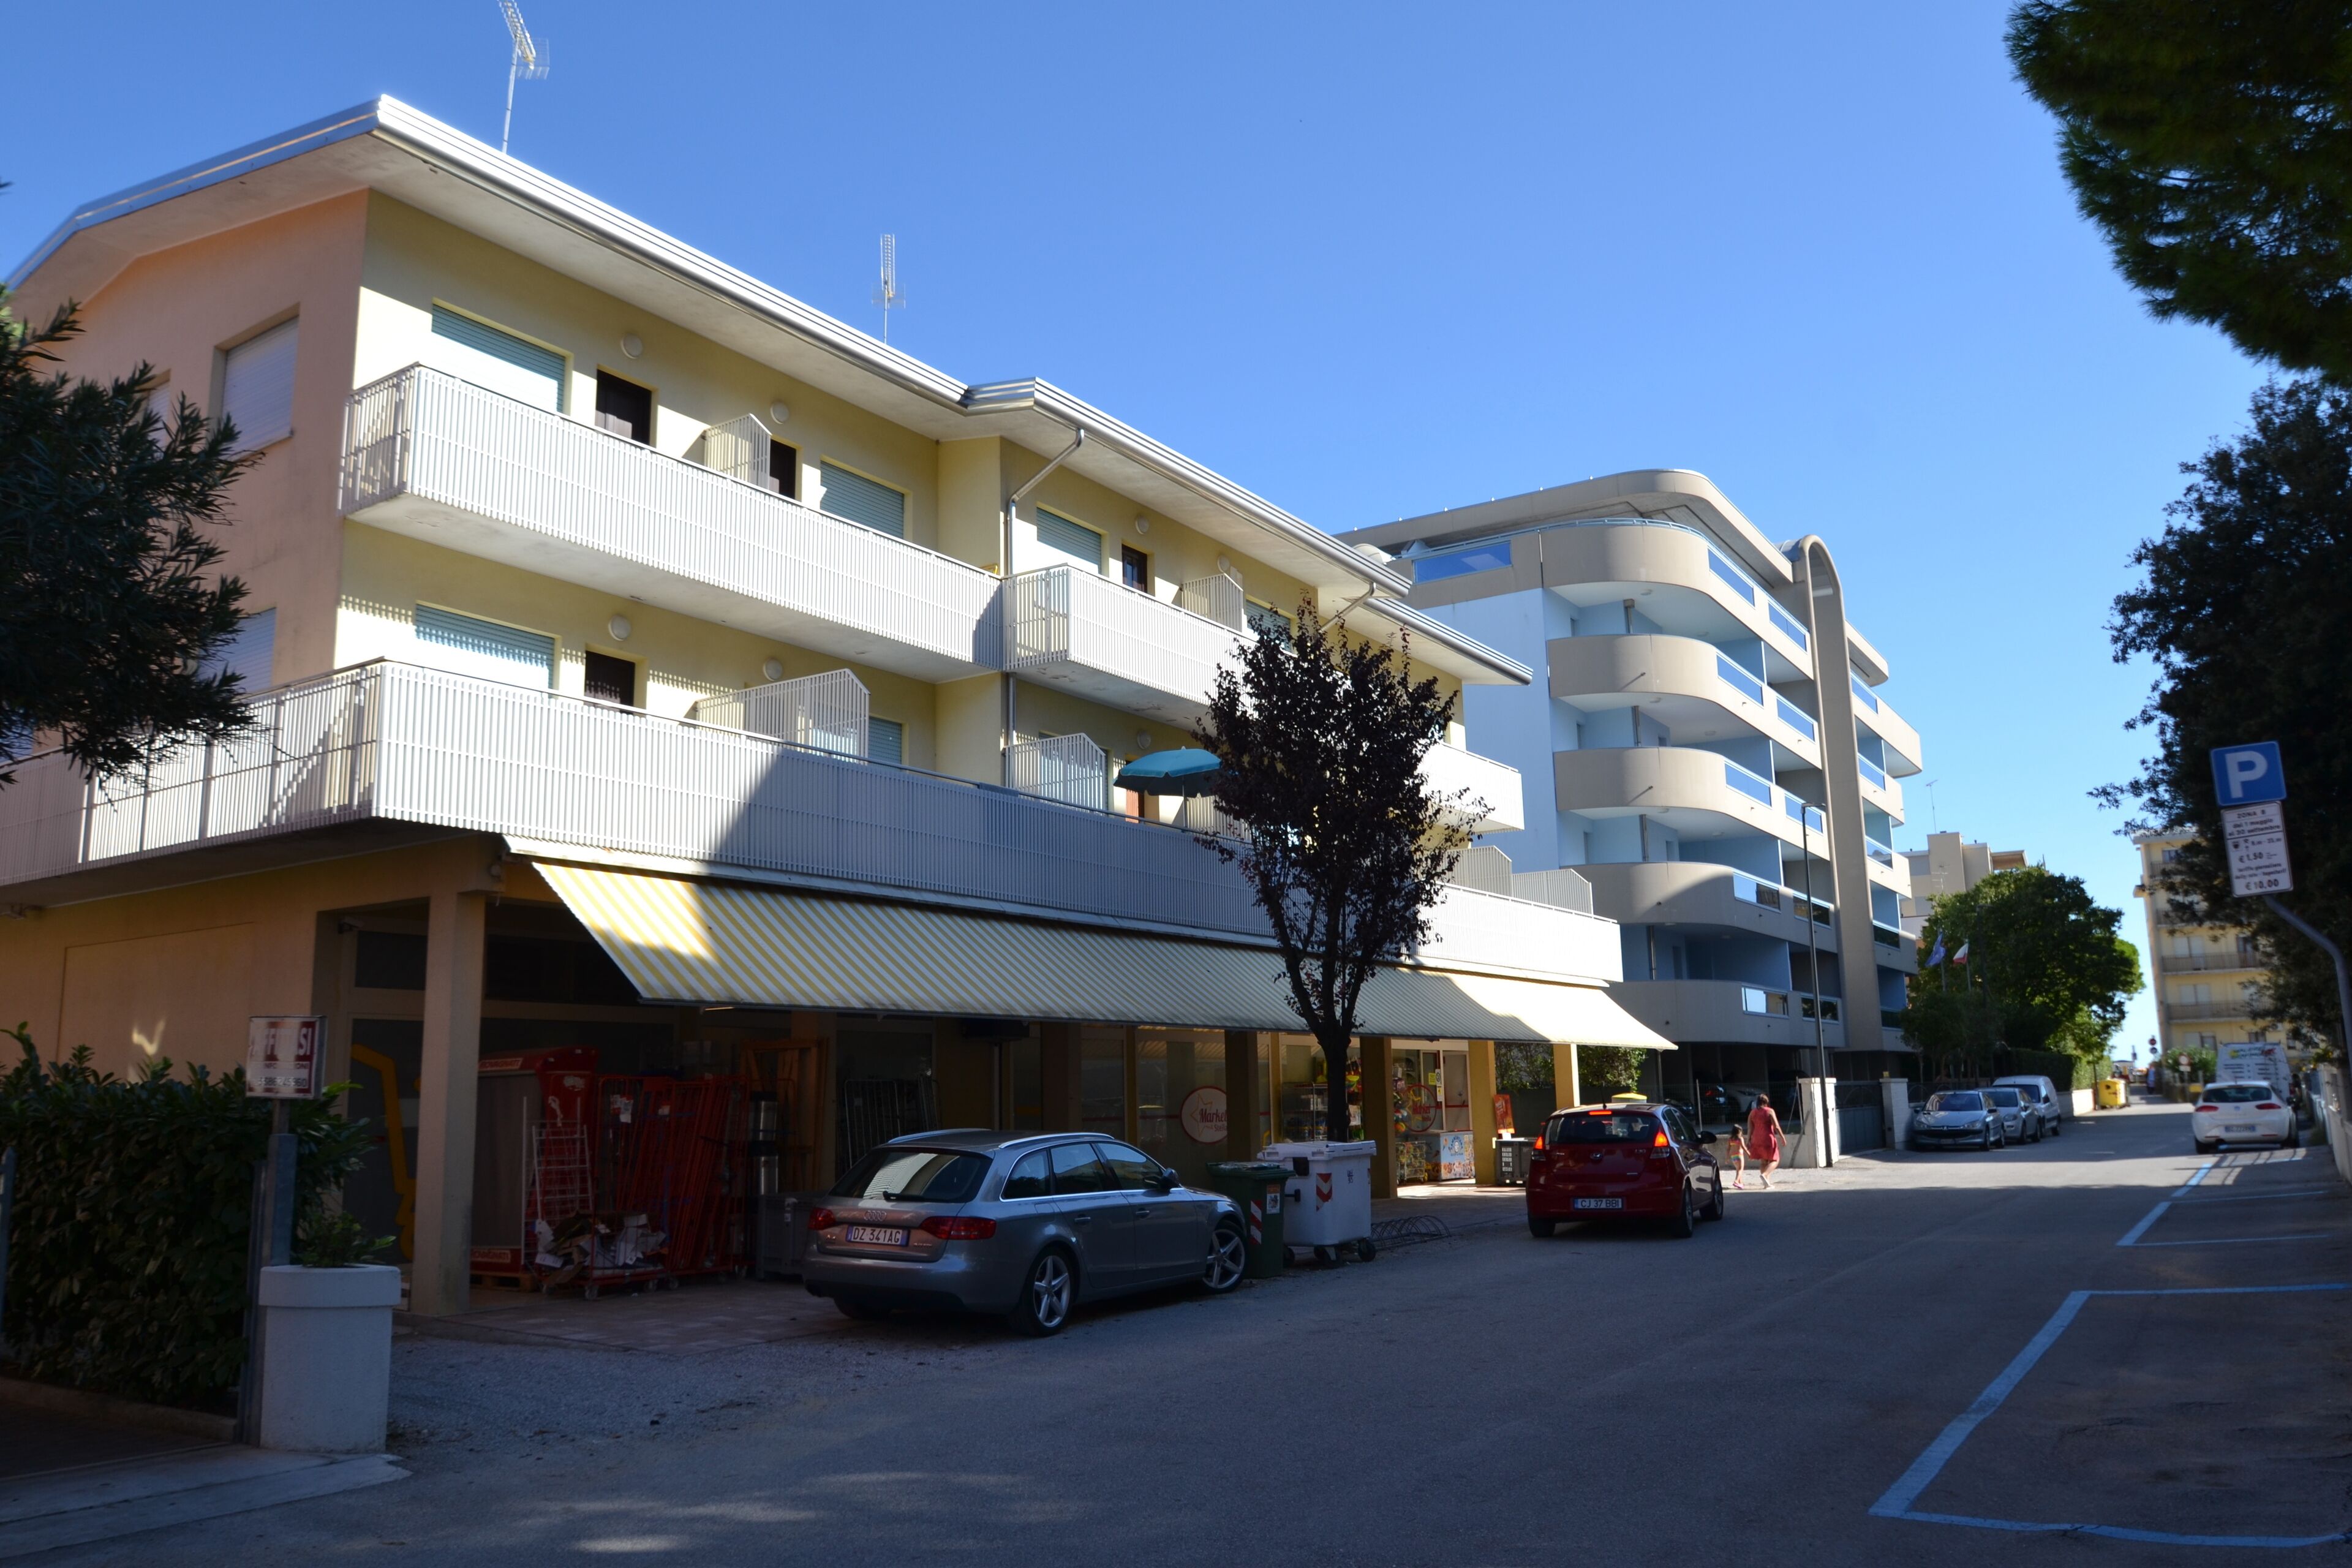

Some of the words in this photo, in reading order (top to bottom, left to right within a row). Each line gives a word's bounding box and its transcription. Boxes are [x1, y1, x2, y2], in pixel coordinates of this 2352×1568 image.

[2225, 751, 2267, 798] P
[853, 1227, 866, 1241] DZ
[869, 1228, 901, 1243] 341AG
